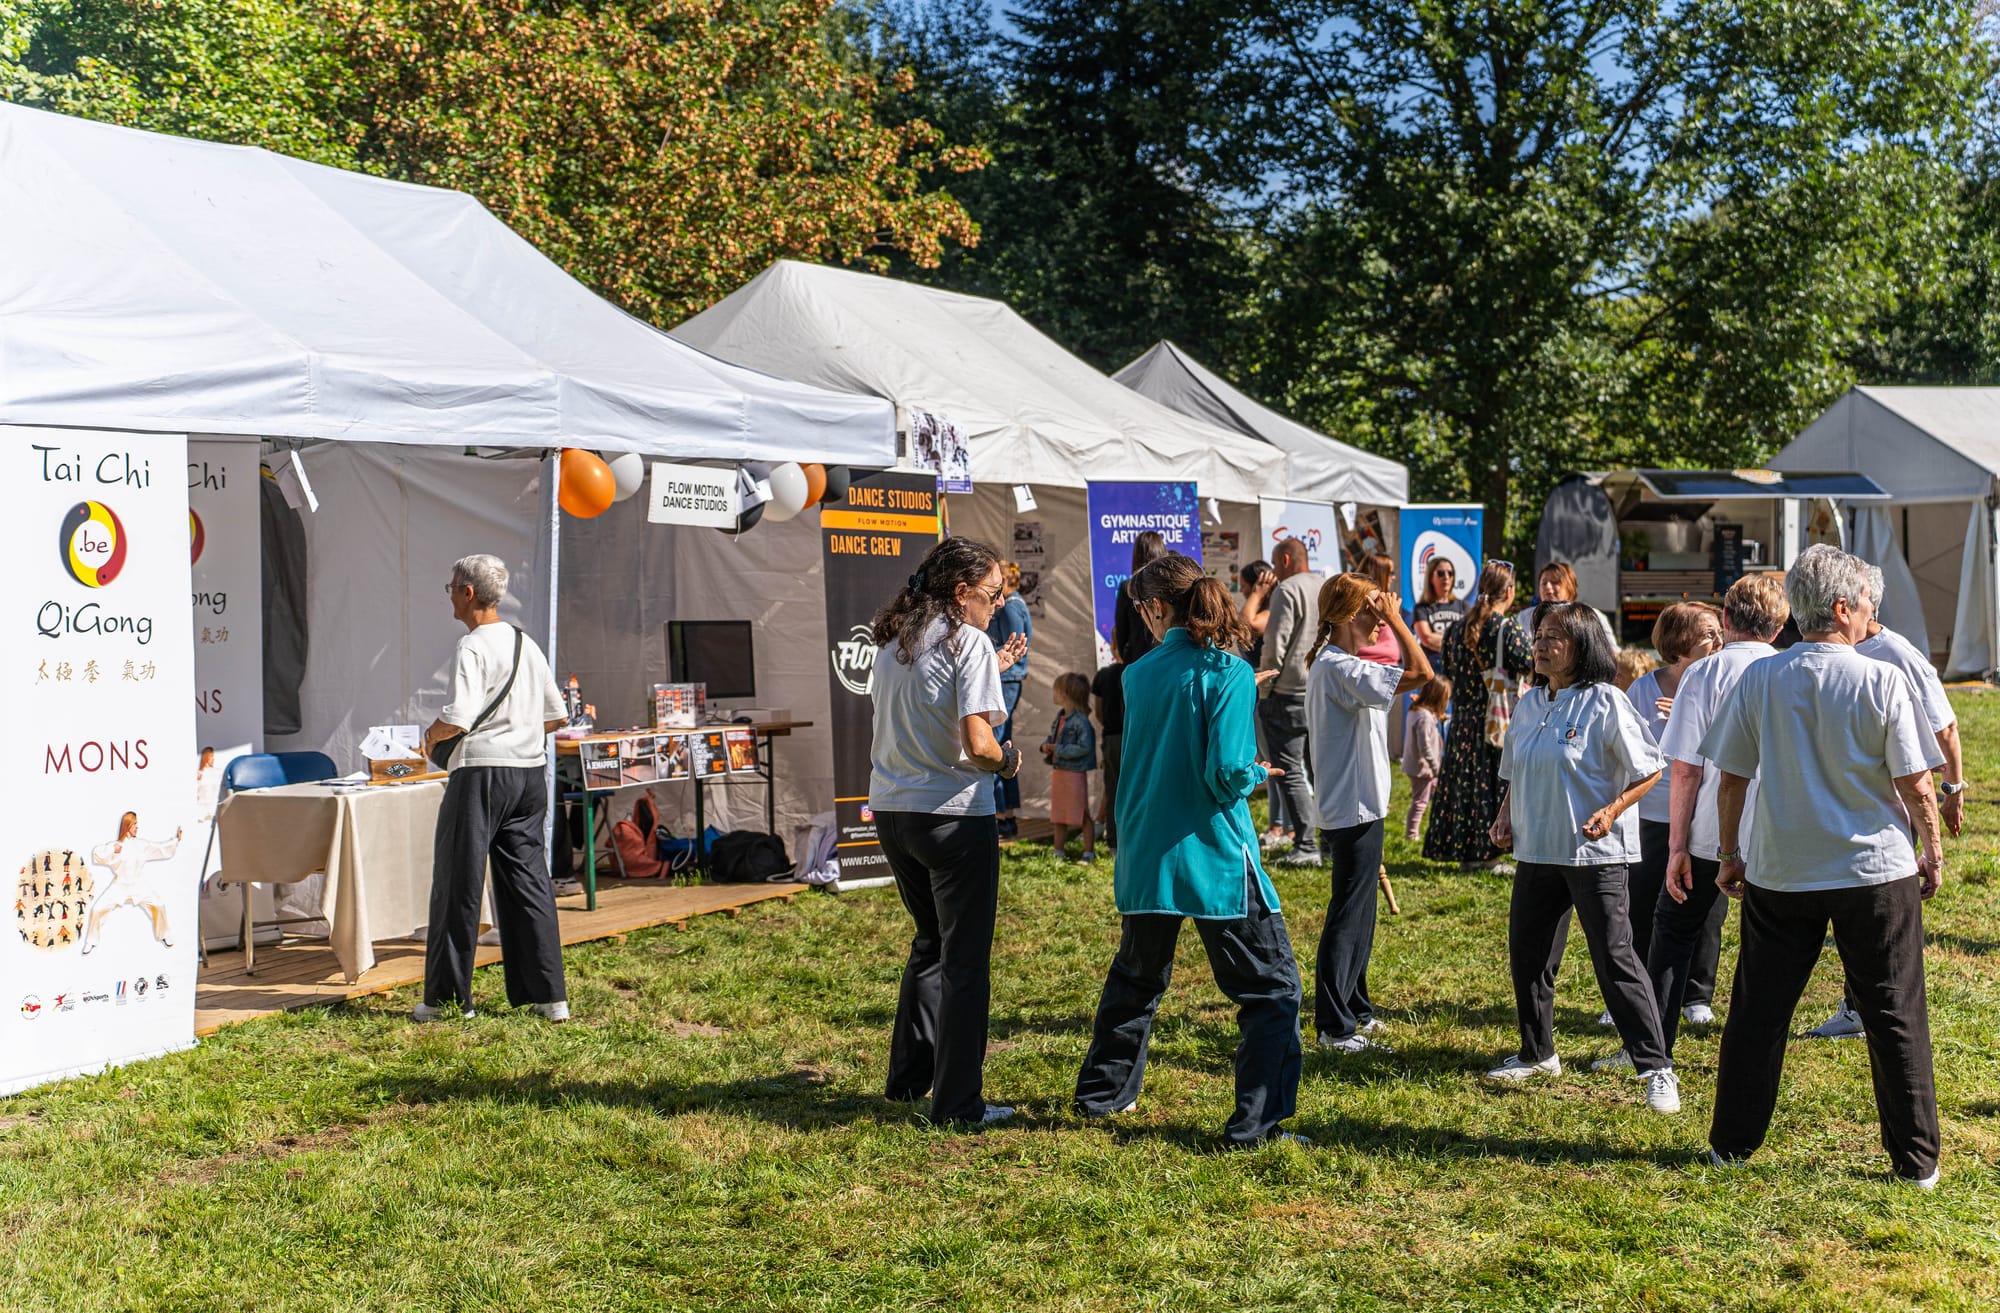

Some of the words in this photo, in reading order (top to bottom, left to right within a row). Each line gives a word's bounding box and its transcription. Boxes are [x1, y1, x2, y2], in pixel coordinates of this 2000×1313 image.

[31, 444, 81, 481] Tai
[96, 452, 150, 489] Chi
[668, 481, 692, 495] FLOW
[693, 484, 725, 497] MOTION
[848, 486, 886, 507] DANCE
[888, 490, 932, 511] STUDIOS
[663, 495, 692, 510] DANCE
[694, 498, 728, 512] STUDIOS
[858, 517, 877, 525] FLOW
[880, 519, 907, 527] MOTION
[1100, 514, 1190, 529] GYMNASTIQUE
[79, 530, 109, 553] .be
[830, 534, 868, 555] DANCE
[870, 537, 902, 556] CREW
[36, 600, 153, 645] QiGong
[45, 739, 149, 774] MONS
